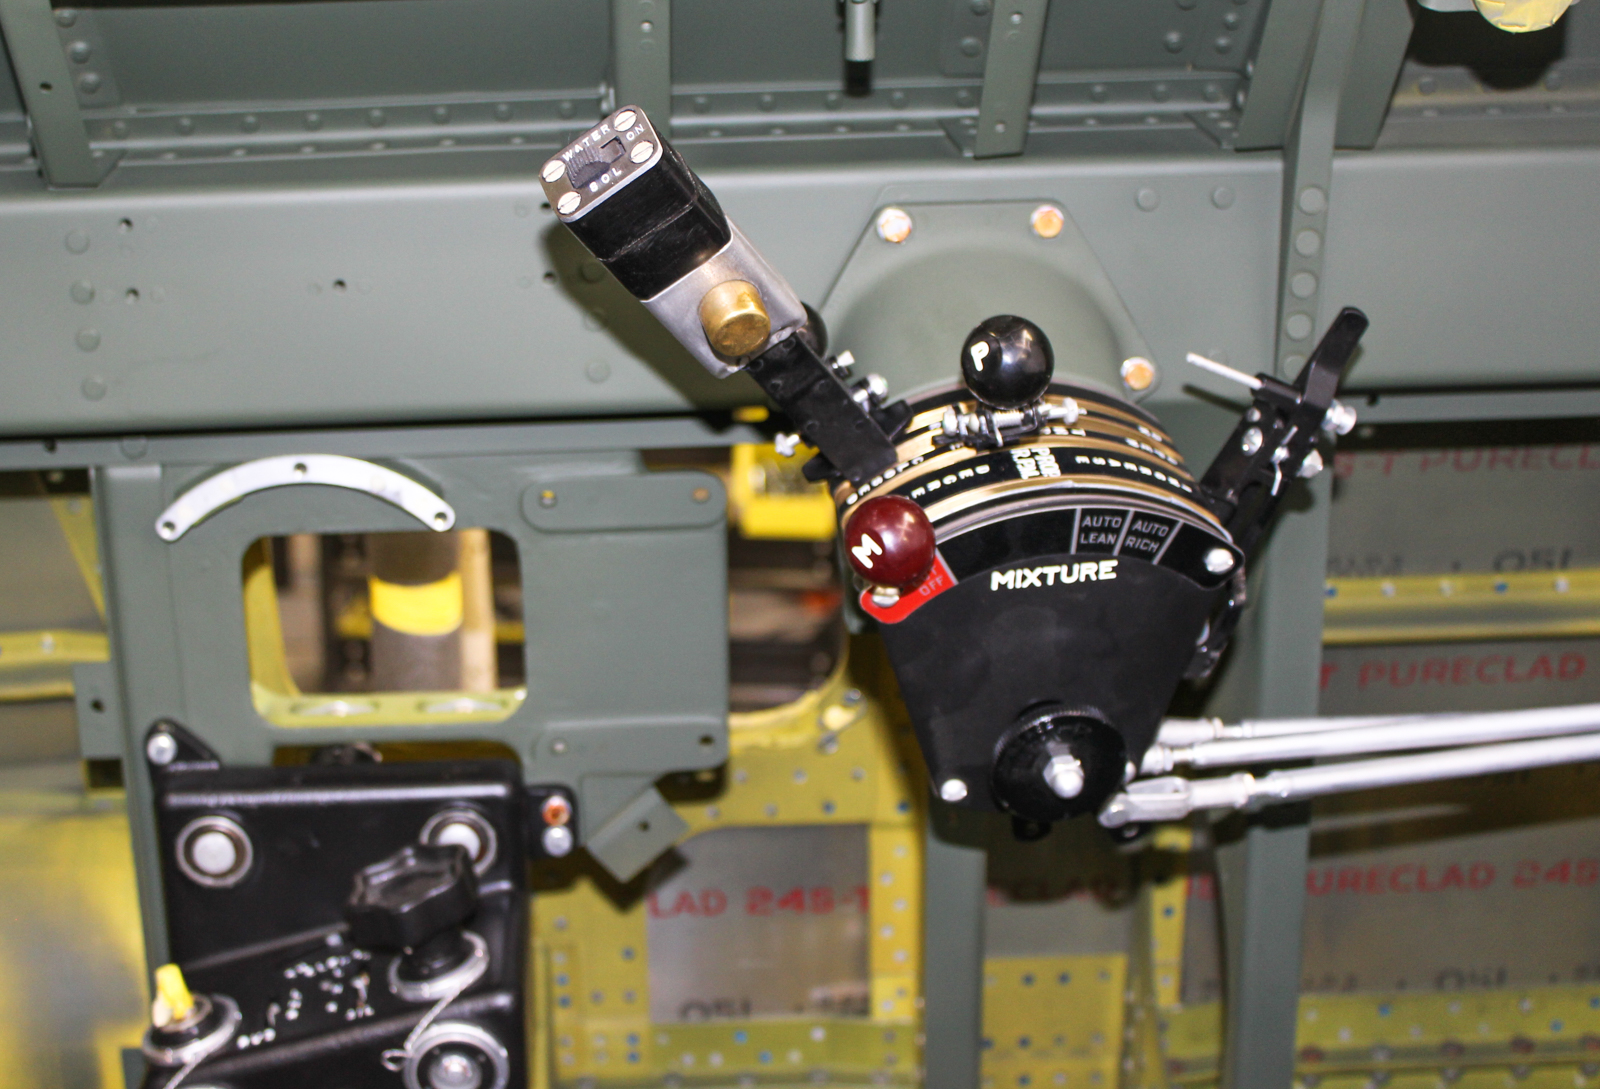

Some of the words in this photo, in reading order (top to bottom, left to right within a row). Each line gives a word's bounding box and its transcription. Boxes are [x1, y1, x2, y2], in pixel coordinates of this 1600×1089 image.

[562, 124, 611, 161] WATER
[625, 124, 645, 141] ON
[588, 167, 623, 193] SOL
[970, 340, 990, 371] P
[906, 464, 991, 500] DECRE
[1075, 455, 1193, 493] INCREASE
[1082, 515, 1122, 529] AUTO
[1132, 519, 1169, 537] AUTO
[851, 533, 883, 569] M
[1080, 532, 1117, 545] LEAN
[1125, 536, 1159, 553] RICH
[919, 576, 944, 597] OFF
[990, 559, 1119, 591] MIXTURE
[1358, 653, 1587, 690] PURECLAD
